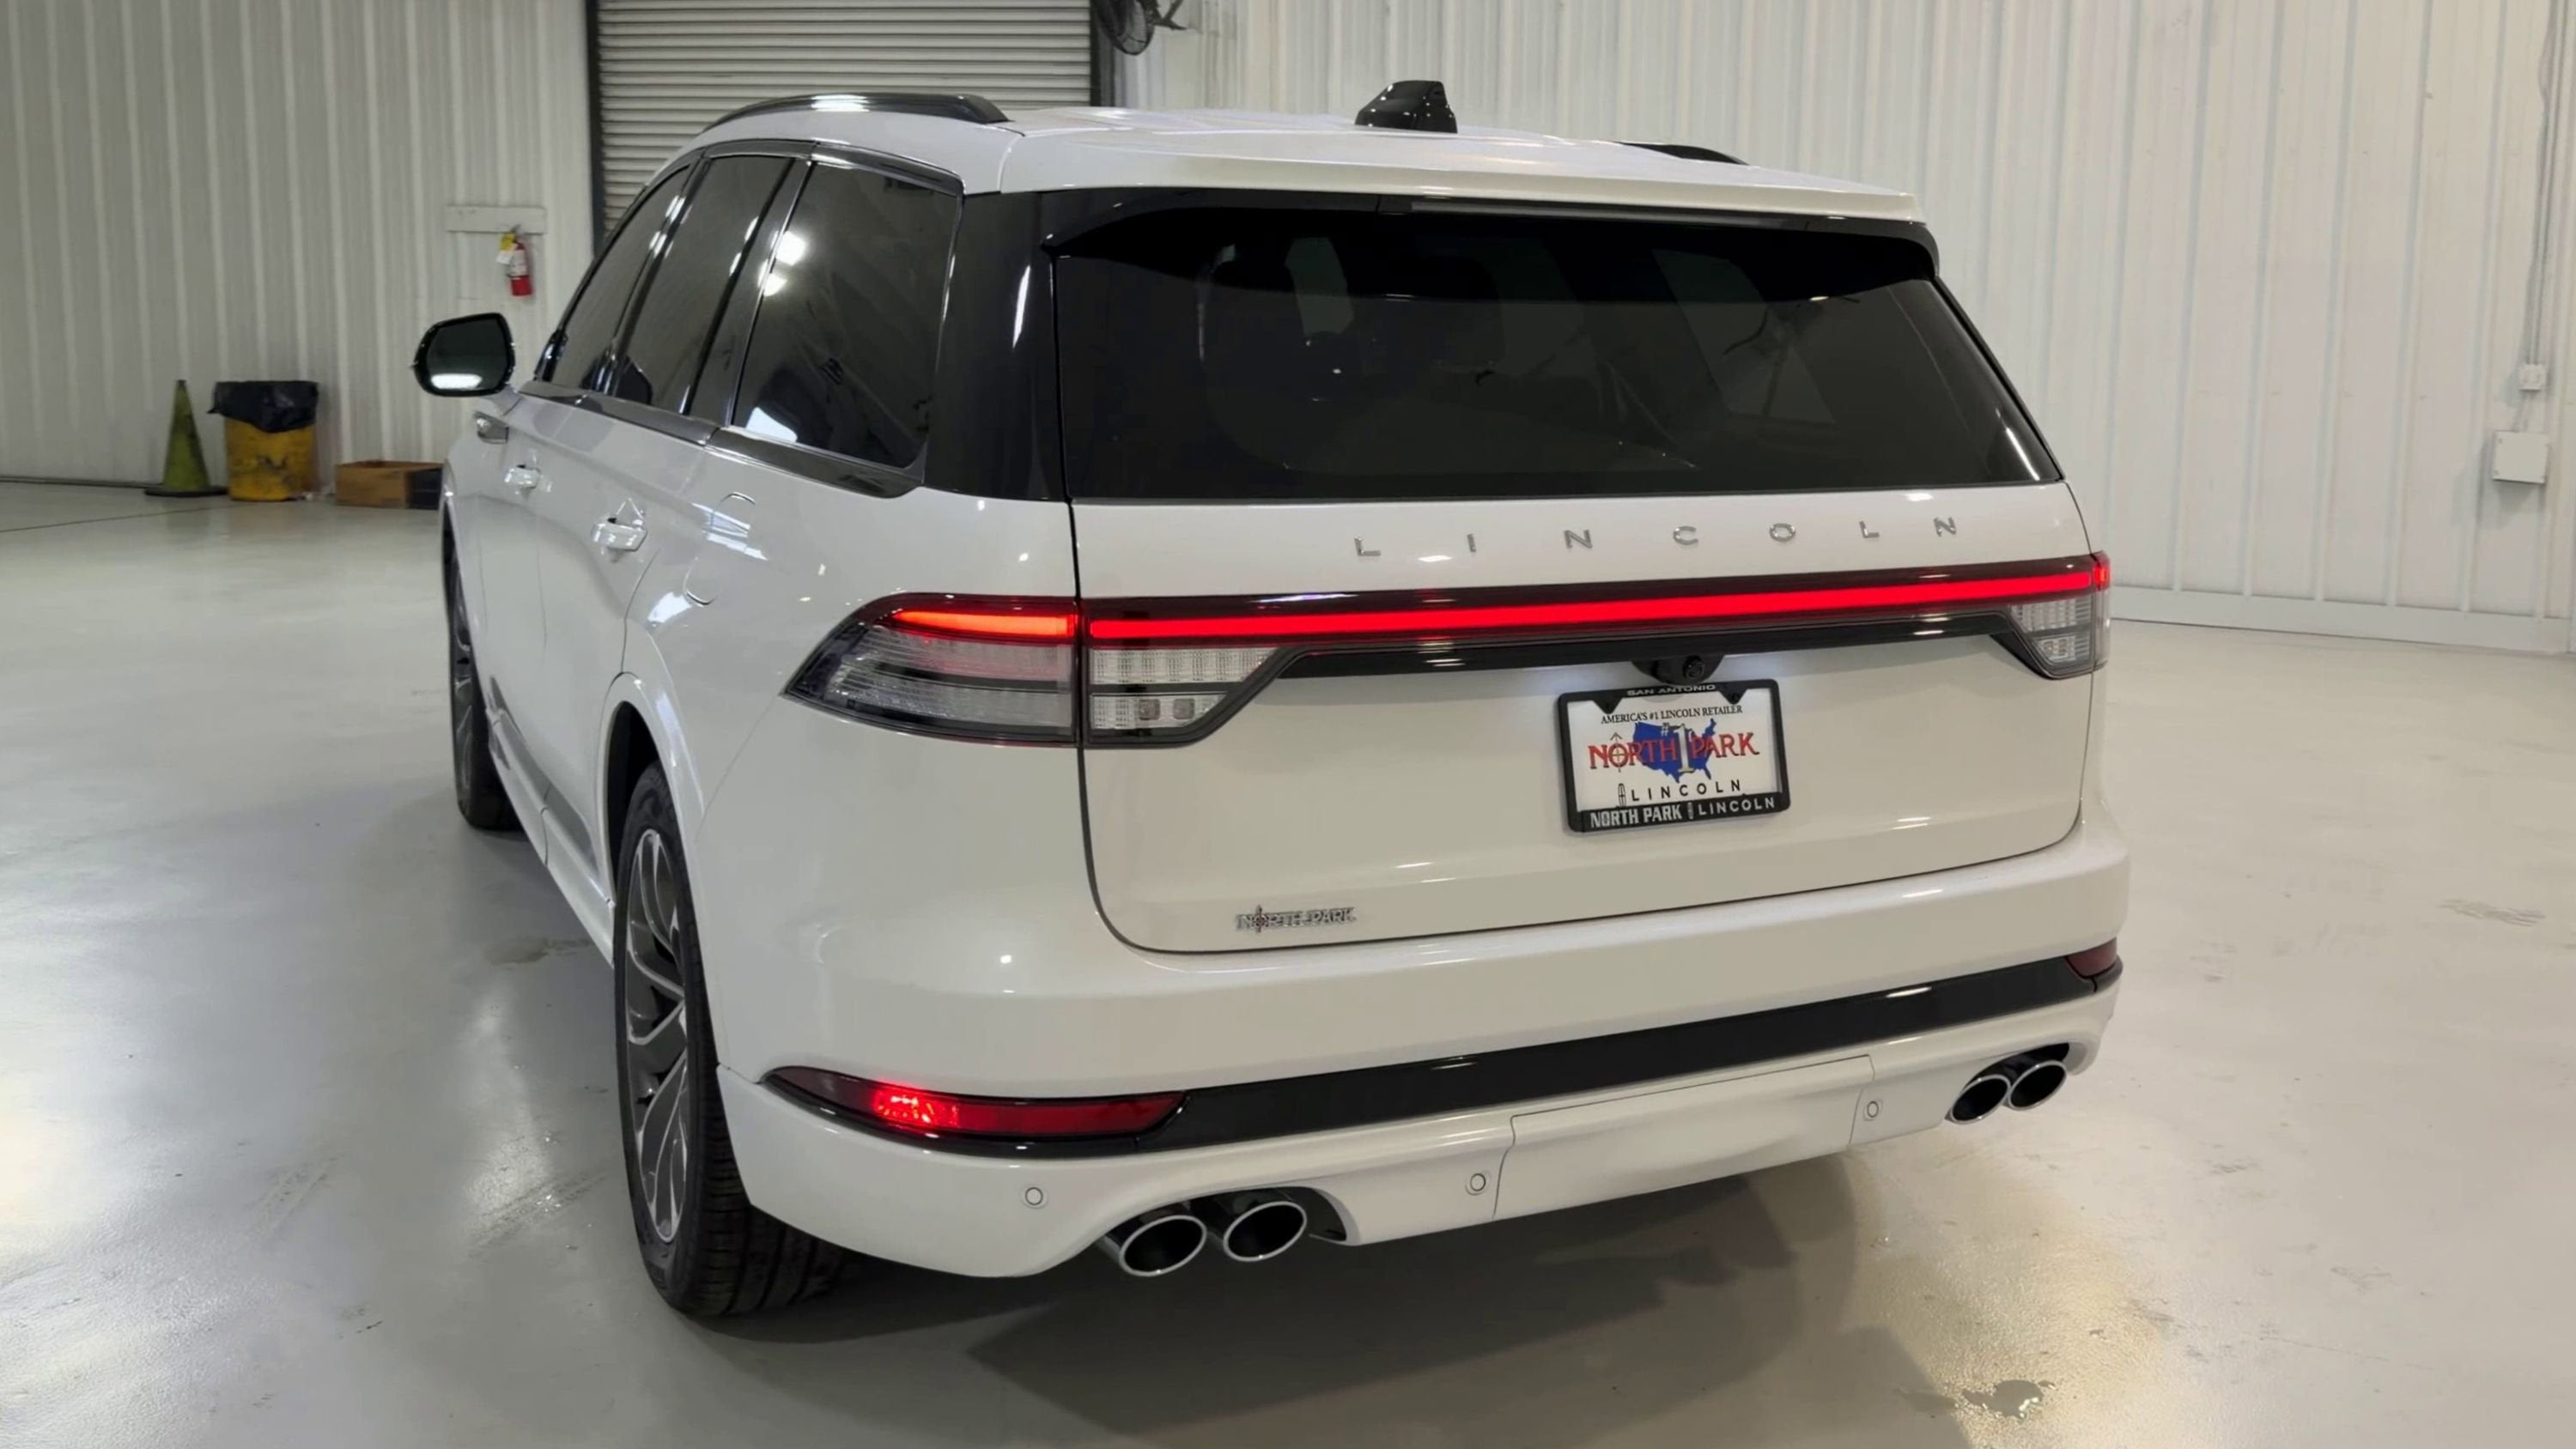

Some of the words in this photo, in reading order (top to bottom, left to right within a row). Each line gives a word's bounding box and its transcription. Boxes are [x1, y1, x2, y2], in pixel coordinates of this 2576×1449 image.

[1354, 516, 1958, 557] LINCOLN
[1626, 688, 1654, 697] SAN
[1658, 683, 1716, 694] ANTONIO
[1601, 712, 1648, 724] AMERICA'S
[1649, 711, 1659, 721] #1
[1661, 706, 1701, 720] LINCOLN
[1702, 704, 1744, 717] RETAILER
[1587, 737, 1677, 771] NORTH
[1689, 731, 1761, 760] PARK
[1631, 779, 1741, 802] LINCOLN
[1589, 807, 1640, 829] NORTH
[1642, 803, 1683, 824] PARK
[1698, 796, 1776, 816] LINCOLN
[1236, 910, 1303, 931] NORTH
[1308, 906, 1358, 926] PARK
